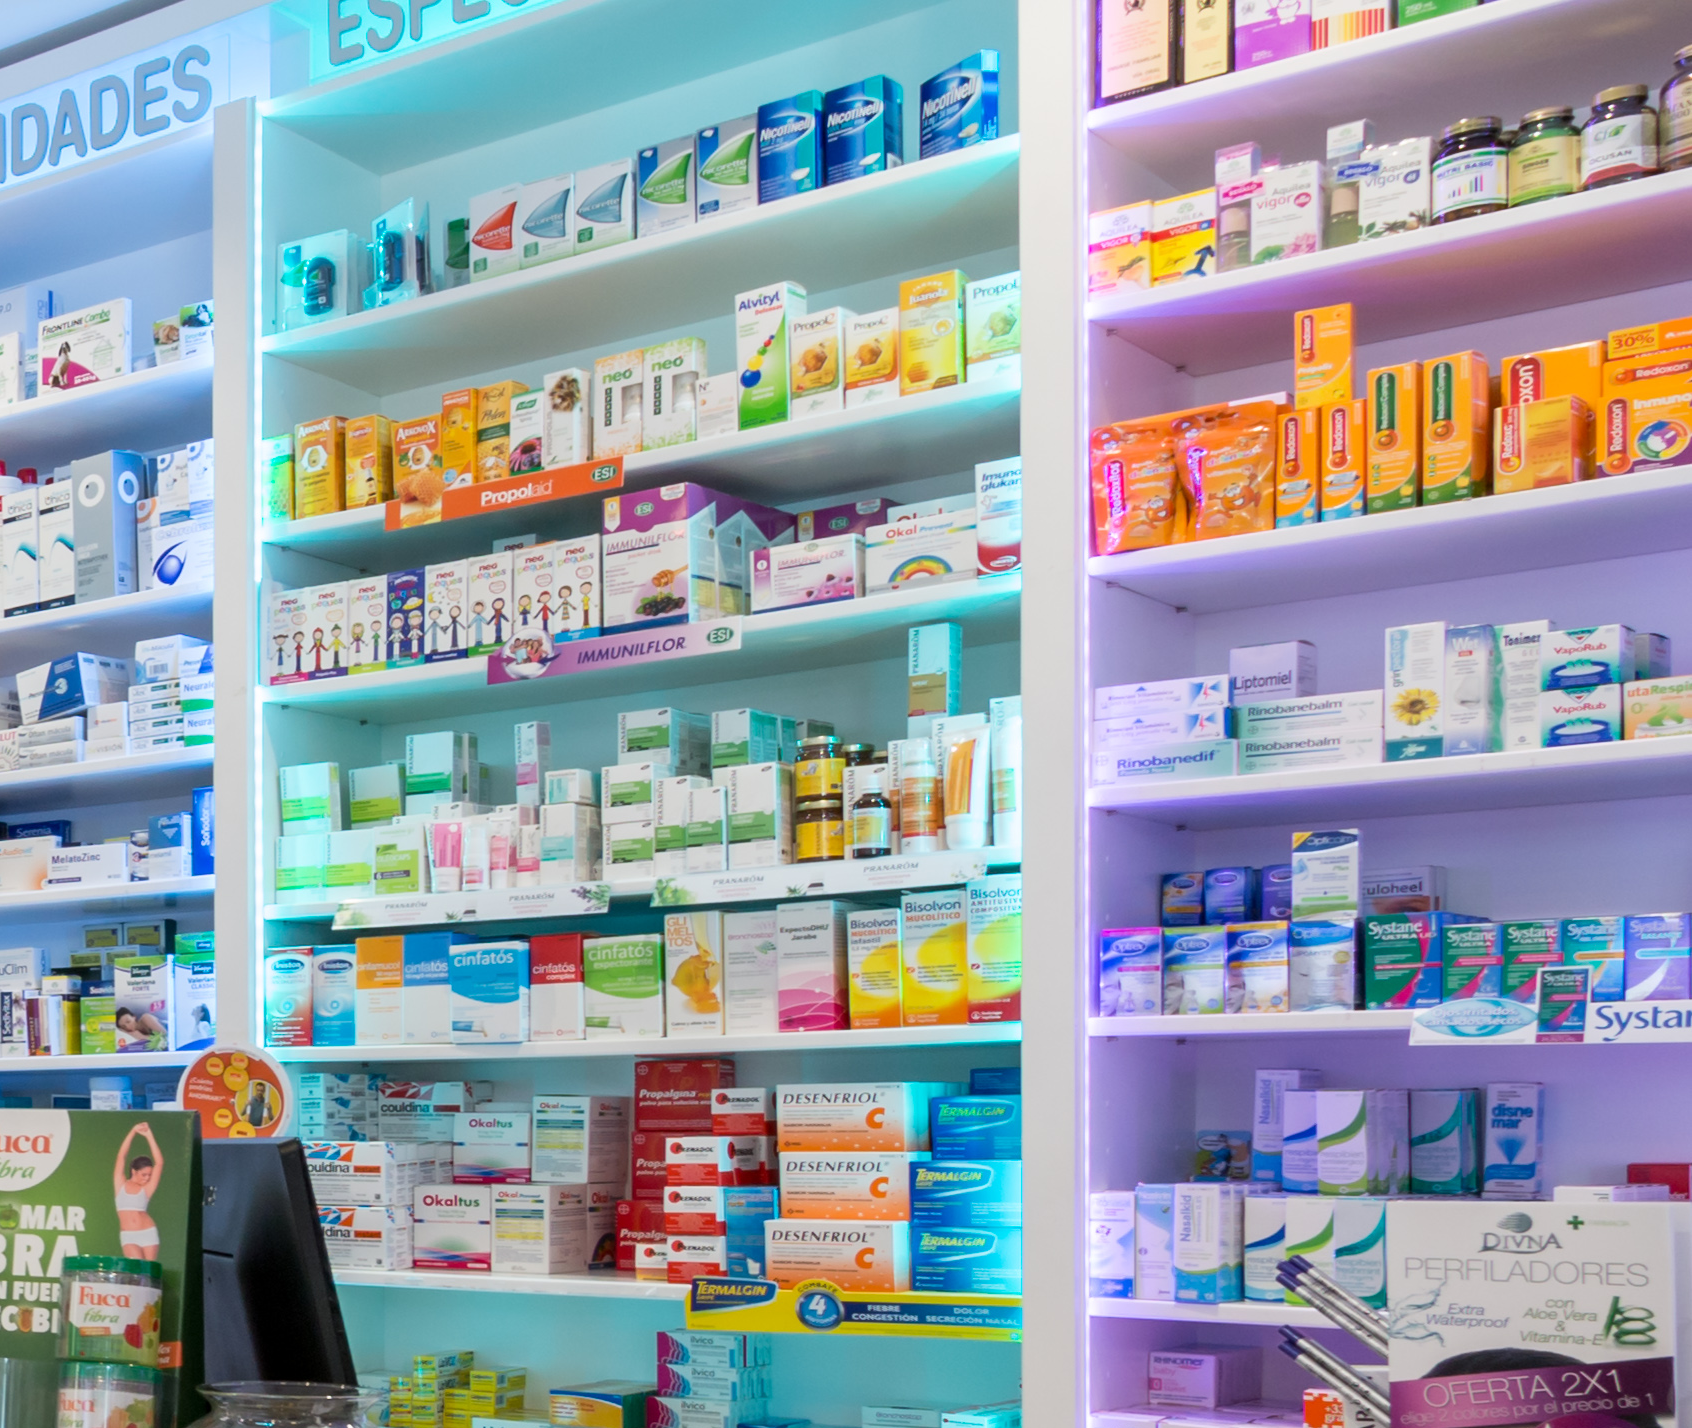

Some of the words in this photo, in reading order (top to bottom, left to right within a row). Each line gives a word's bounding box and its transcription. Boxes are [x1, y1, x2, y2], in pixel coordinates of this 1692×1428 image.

[577, 637, 686, 665] IMMUNILFLOR
[1553, 642, 1606, 656] VapoRub
[1234, 671, 1292, 692] Liptomiel
[1247, 700, 1342, 717] Rinobanebalm
[1117, 749, 1215, 768] Rinobanedif
[905, 899, 962, 916] Bisolvon
[453, 950, 514, 968] cinfatós
[783, 1091, 884, 1105] DESENFRIOL
[916, 1169, 981, 1183] TERMALGIN
[1405, 1257, 1649, 1288] PERFILADORES
[697, 1281, 767, 1296] TERMALGIN
[1426, 1314, 1509, 1330] Waterproof
[1423, 1375, 1550, 1409] OFERTA
[1560, 1369, 1622, 1399] 2X1
